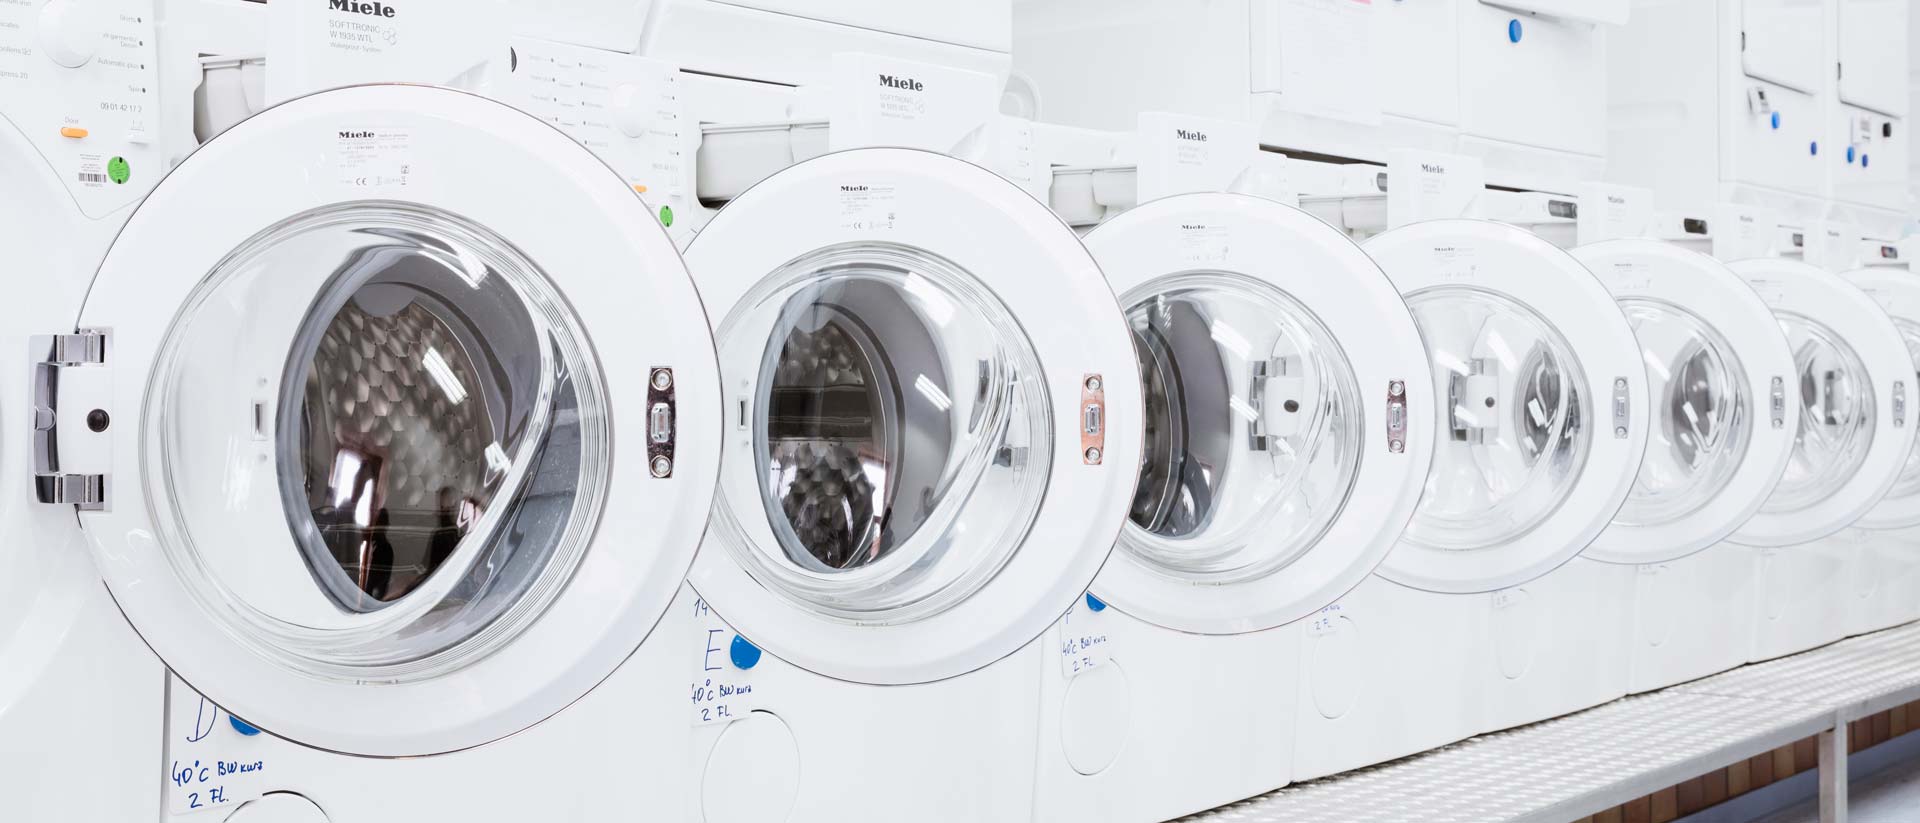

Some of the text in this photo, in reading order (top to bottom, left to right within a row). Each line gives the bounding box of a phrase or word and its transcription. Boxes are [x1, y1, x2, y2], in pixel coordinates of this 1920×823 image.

[328, 0, 396, 18] Miele
[329, 30, 338, 38] W
[878, 74, 924, 92] Miele
[338, 131, 376, 139] Miele
[1176, 129, 1208, 142] Miele
[1421, 163, 1446, 174] Miele
[704, 629, 724, 671] E
[1072, 660, 1081, 672] 2
[719, 684, 735, 698] BW
[186, 696, 217, 742] D
[701, 708, 712, 721] 2
[217, 760, 237, 776] BW
[188, 792, 203, 808] 2
